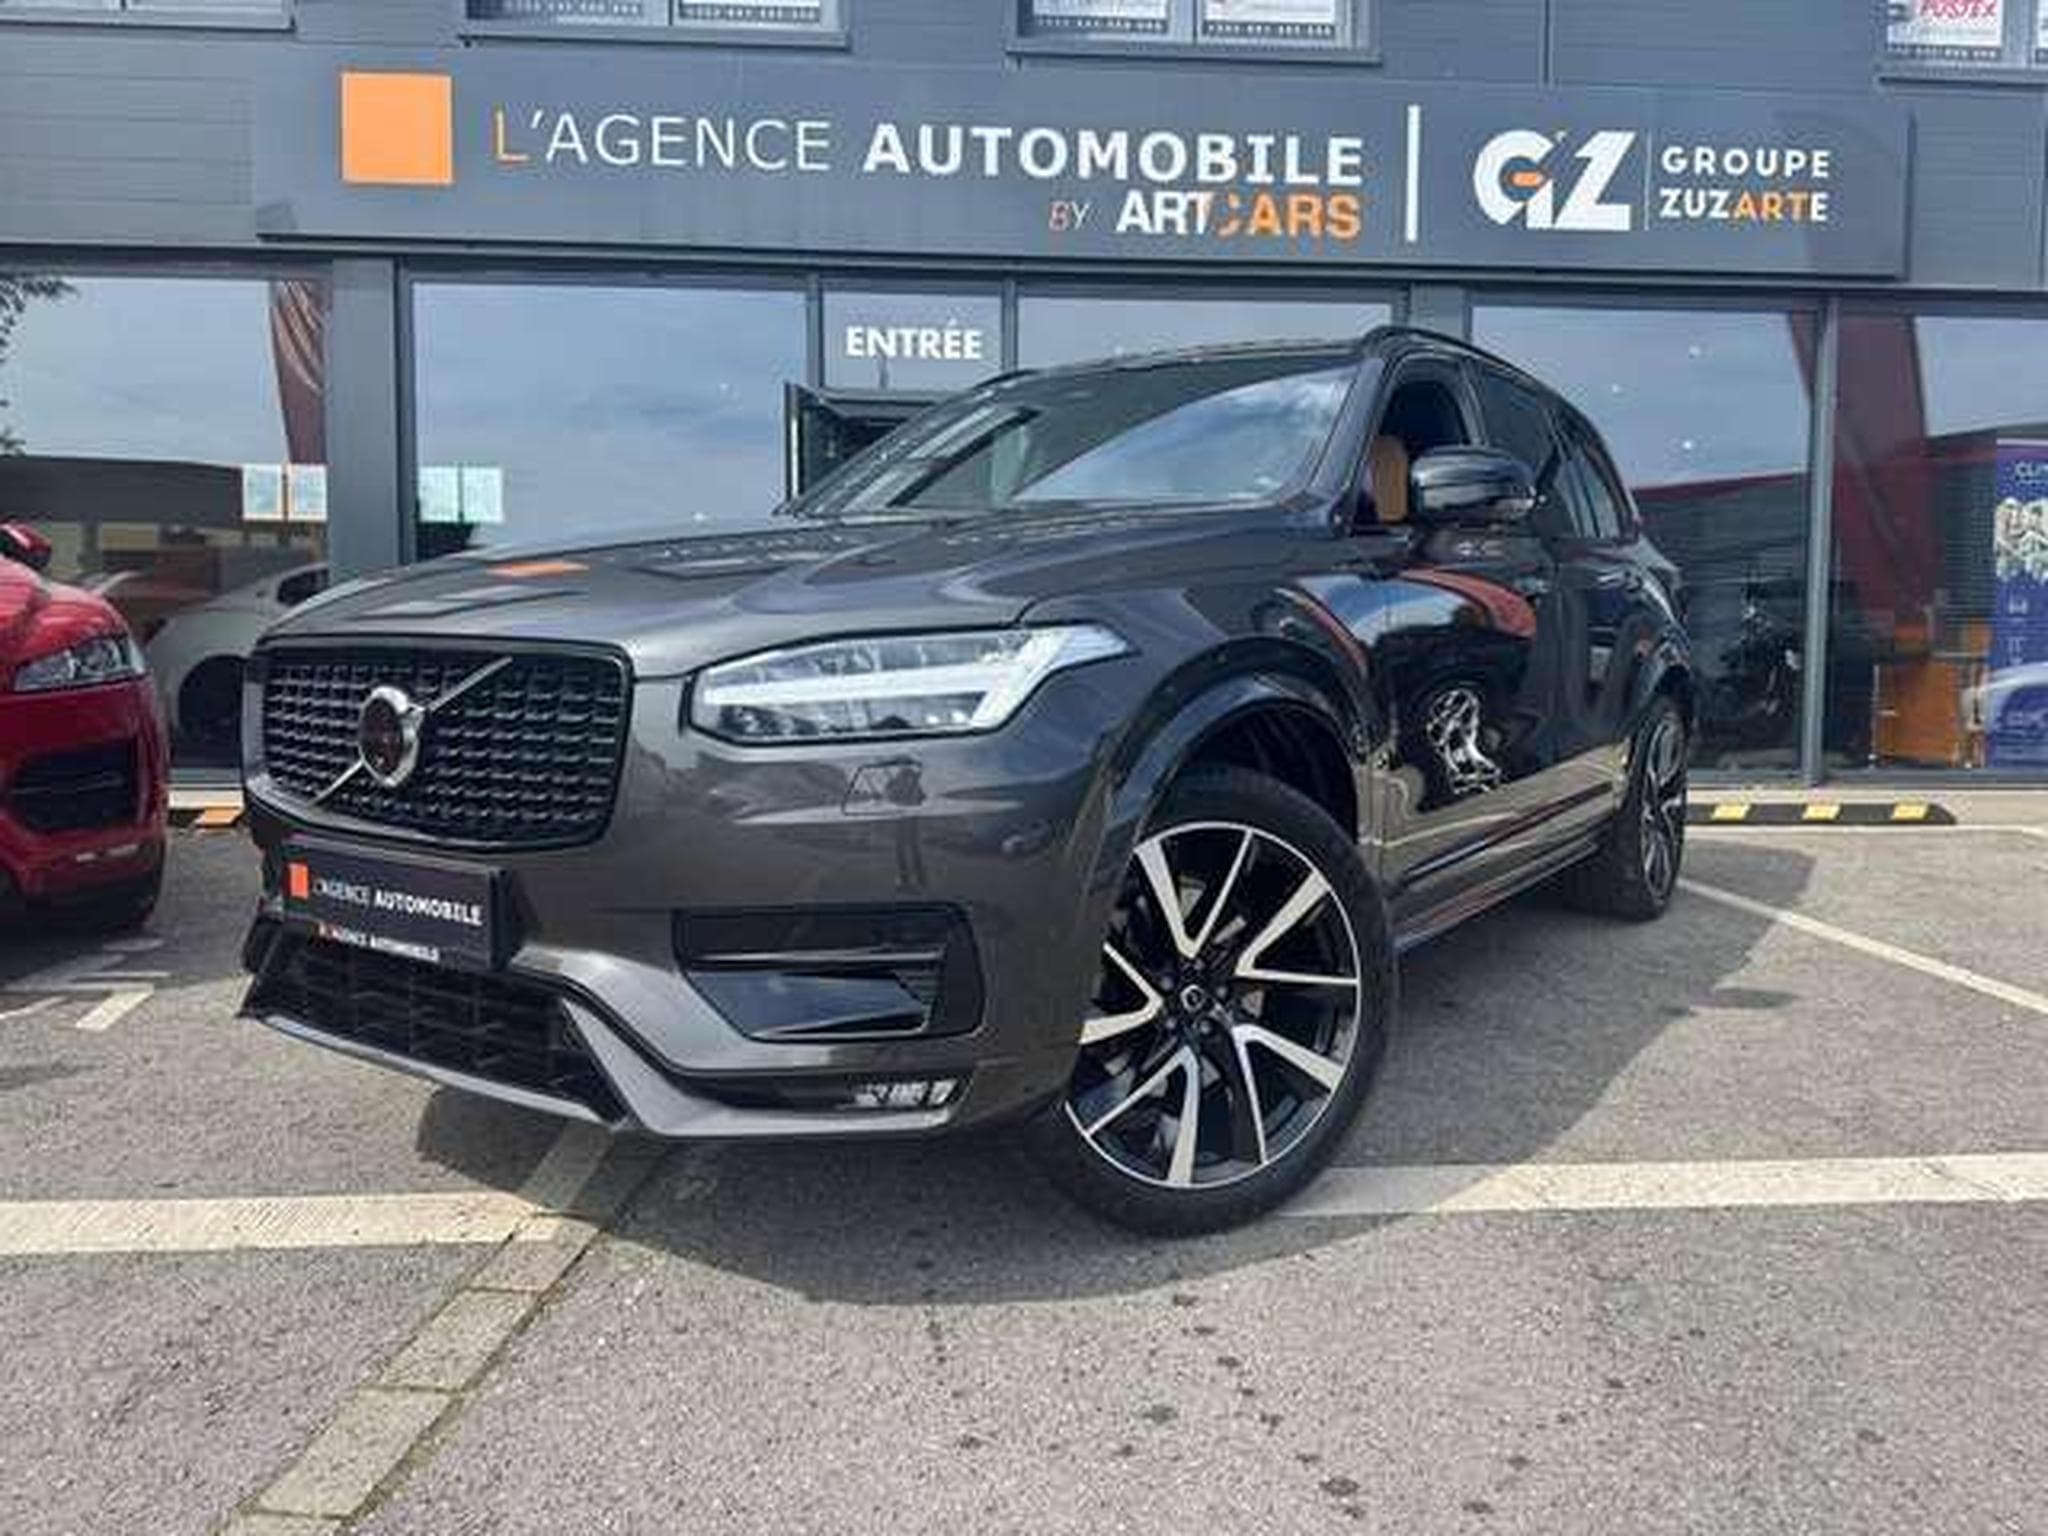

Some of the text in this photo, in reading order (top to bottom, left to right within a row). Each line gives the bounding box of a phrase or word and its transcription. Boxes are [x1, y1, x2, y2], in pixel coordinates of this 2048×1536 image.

[494, 108, 1363, 186] L'AGENCE AUTOMOBILE
[1661, 146, 1831, 179] GROUPE
[1047, 199, 1090, 231] BY
[1659, 188, 1829, 222] ZUZARTE
[846, 318, 983, 360] ENTRÉE
[374, 889, 482, 926] AUTOMOBILE
